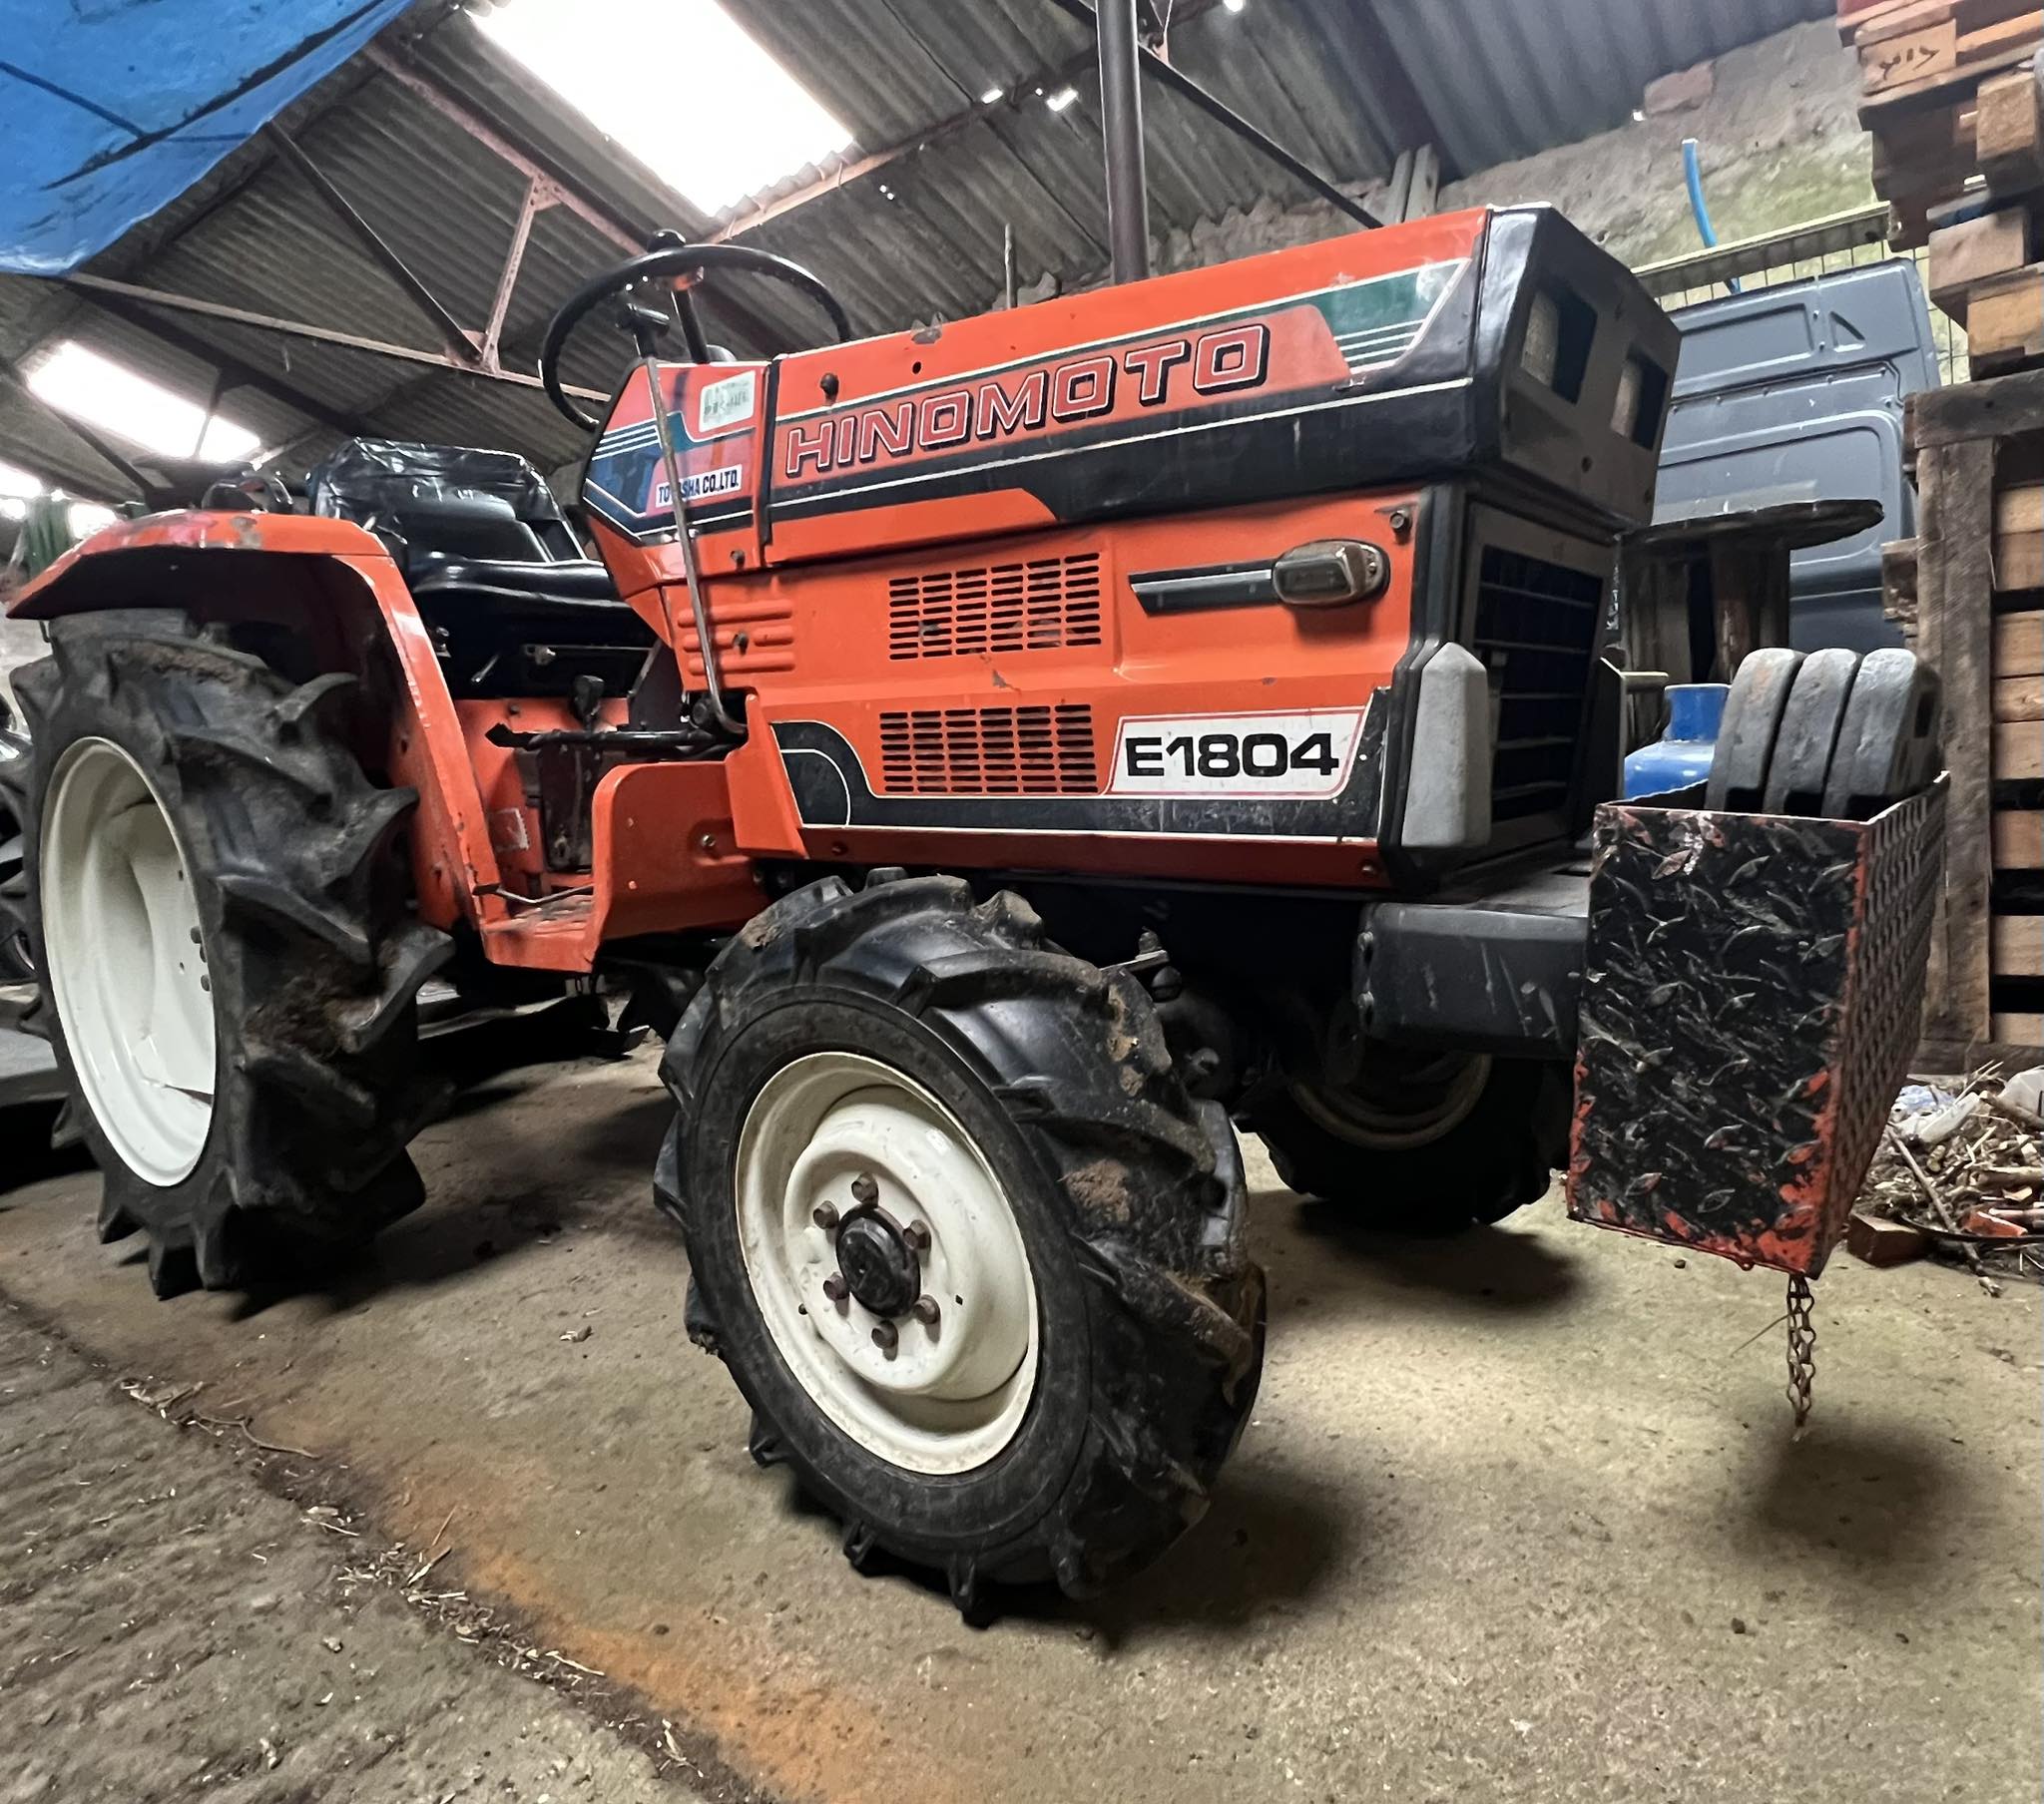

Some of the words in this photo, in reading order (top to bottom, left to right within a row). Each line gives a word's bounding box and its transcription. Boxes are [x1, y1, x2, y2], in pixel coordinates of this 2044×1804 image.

[785, 323, 1271, 477] HINOMOTO
[659, 478, 701, 503] TOSHA
[1125, 732, 1340, 778] E1804
